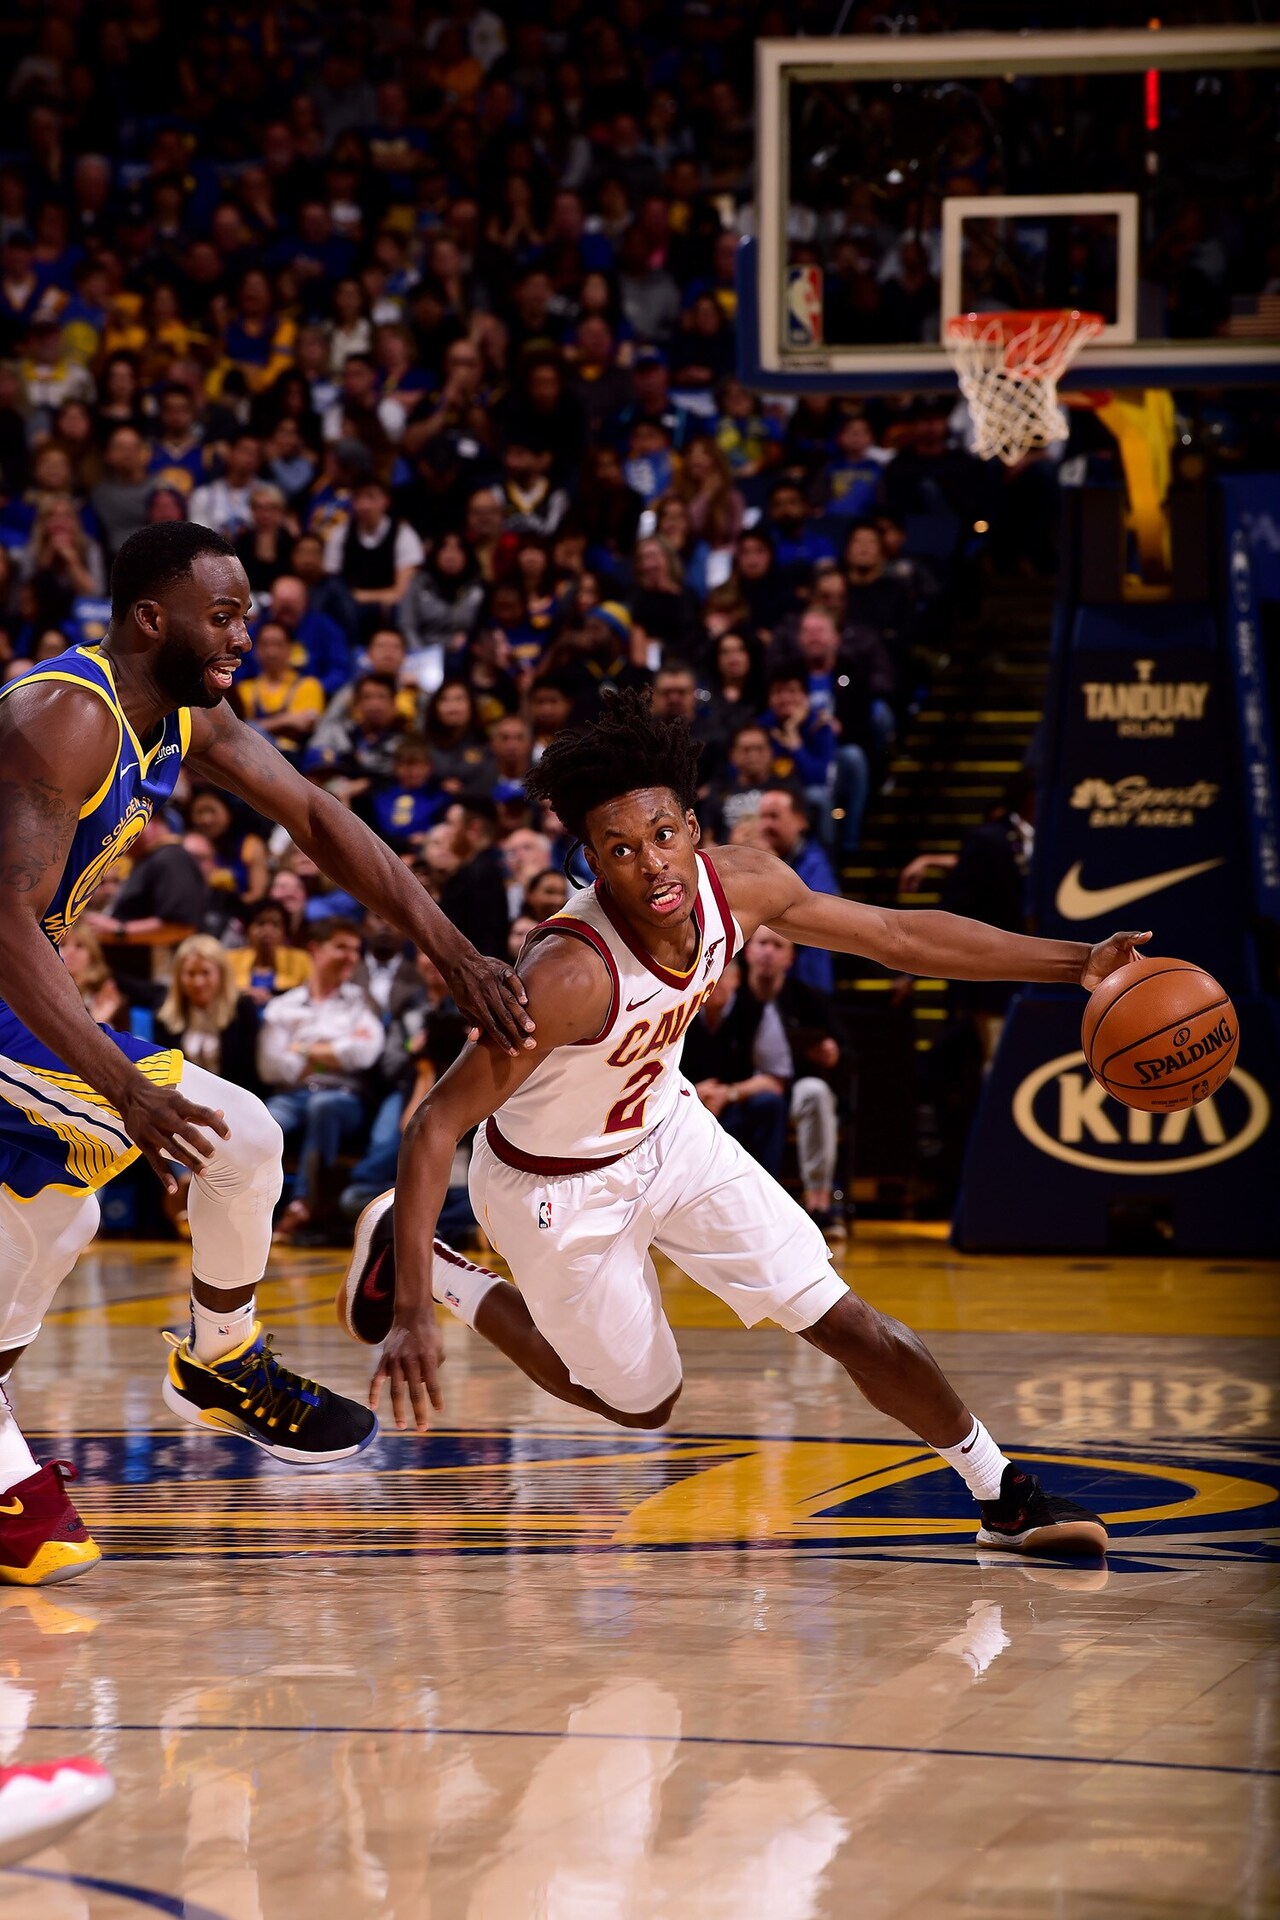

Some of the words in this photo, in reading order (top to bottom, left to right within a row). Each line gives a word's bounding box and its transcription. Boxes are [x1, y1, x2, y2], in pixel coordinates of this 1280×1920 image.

[1083, 682, 1209, 720] TANDUAY
[156, 744, 180, 760] uten
[101, 797, 141, 847] GOLDEN
[1134, 1017, 1234, 1085] SPALDING
[603, 1059, 666, 1134] 2
